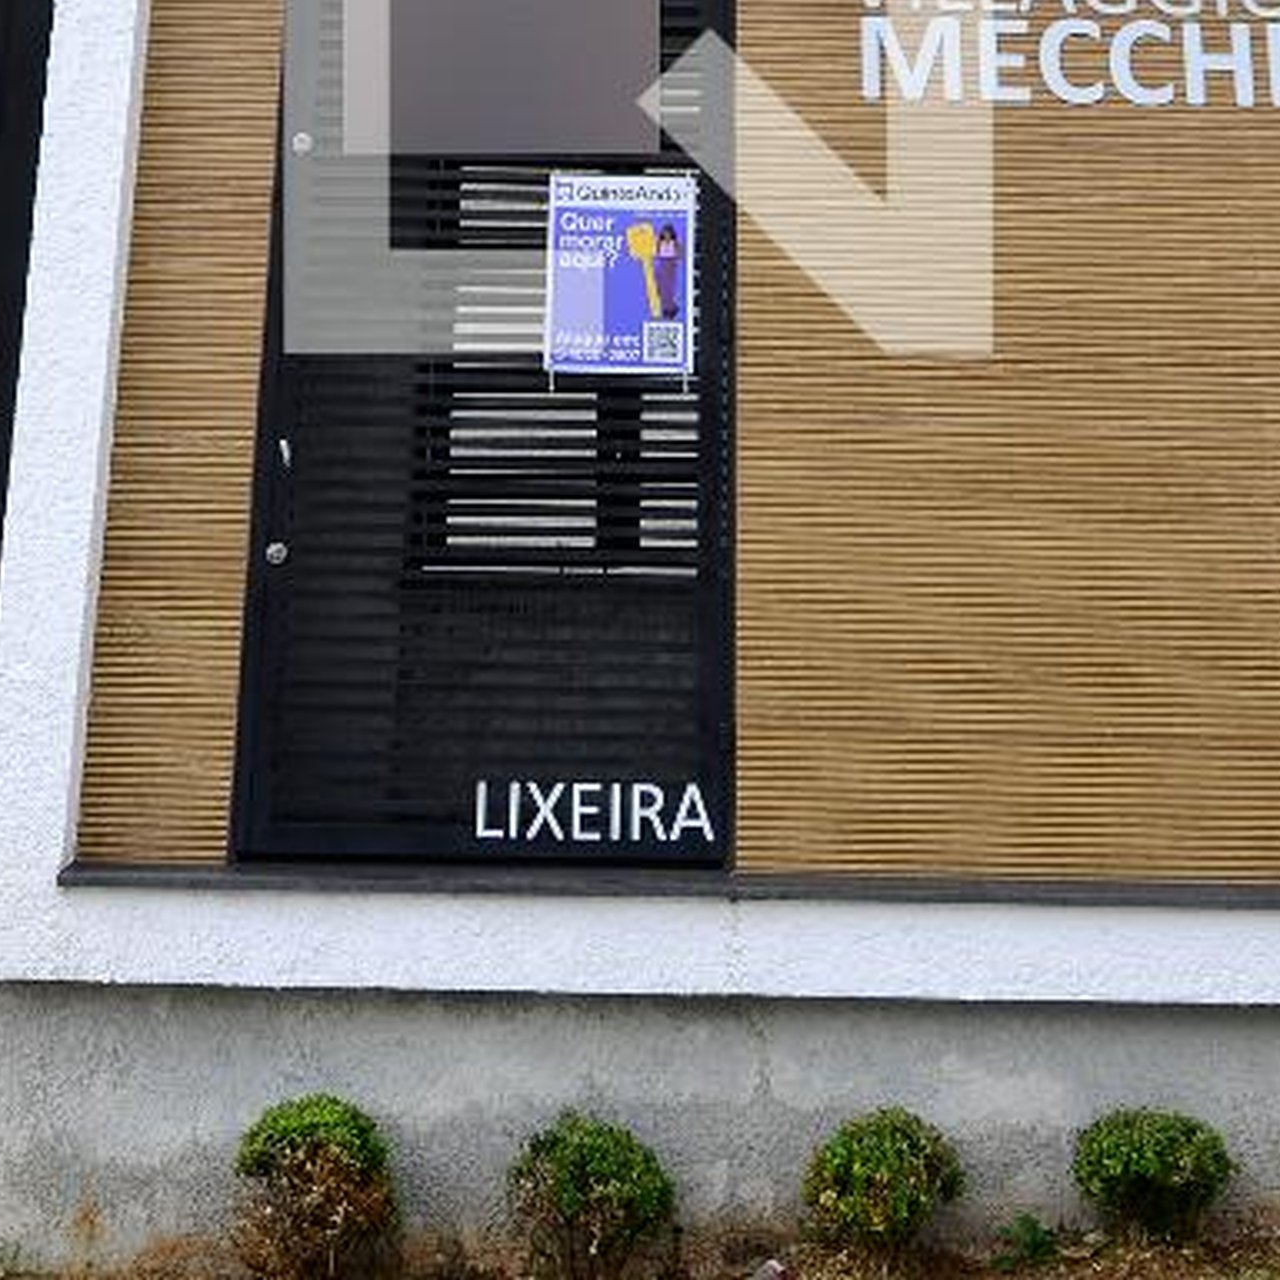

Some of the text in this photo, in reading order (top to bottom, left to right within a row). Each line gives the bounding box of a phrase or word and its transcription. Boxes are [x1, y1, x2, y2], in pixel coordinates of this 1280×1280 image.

[560, 211, 614, 232] Quer
[559, 234, 624, 251] morar
[476, 780, 715, 841] LIXEIRA
